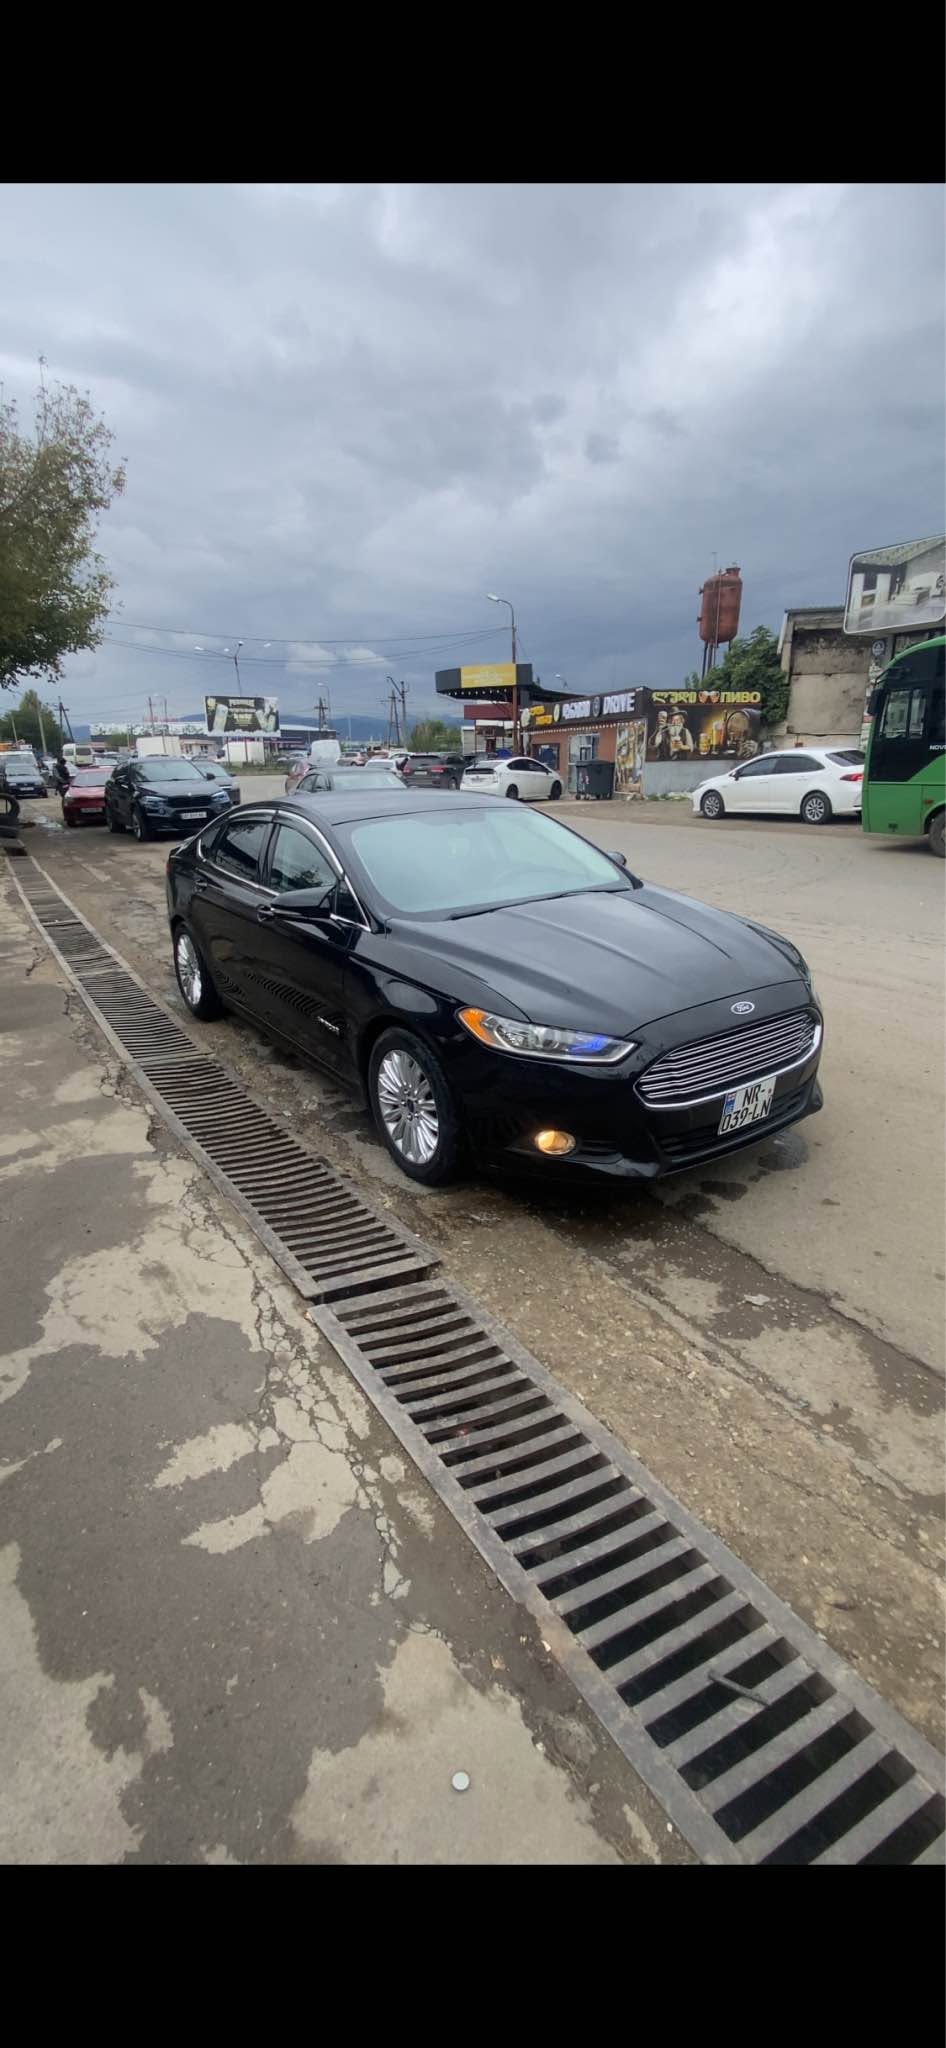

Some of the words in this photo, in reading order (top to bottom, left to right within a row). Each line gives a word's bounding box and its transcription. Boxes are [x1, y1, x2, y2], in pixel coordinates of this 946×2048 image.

[603, 692, 636, 715] DRIVE
[720, 691, 760, 703] ПИВО
[721, 1098, 772, 1131] 039-LN
